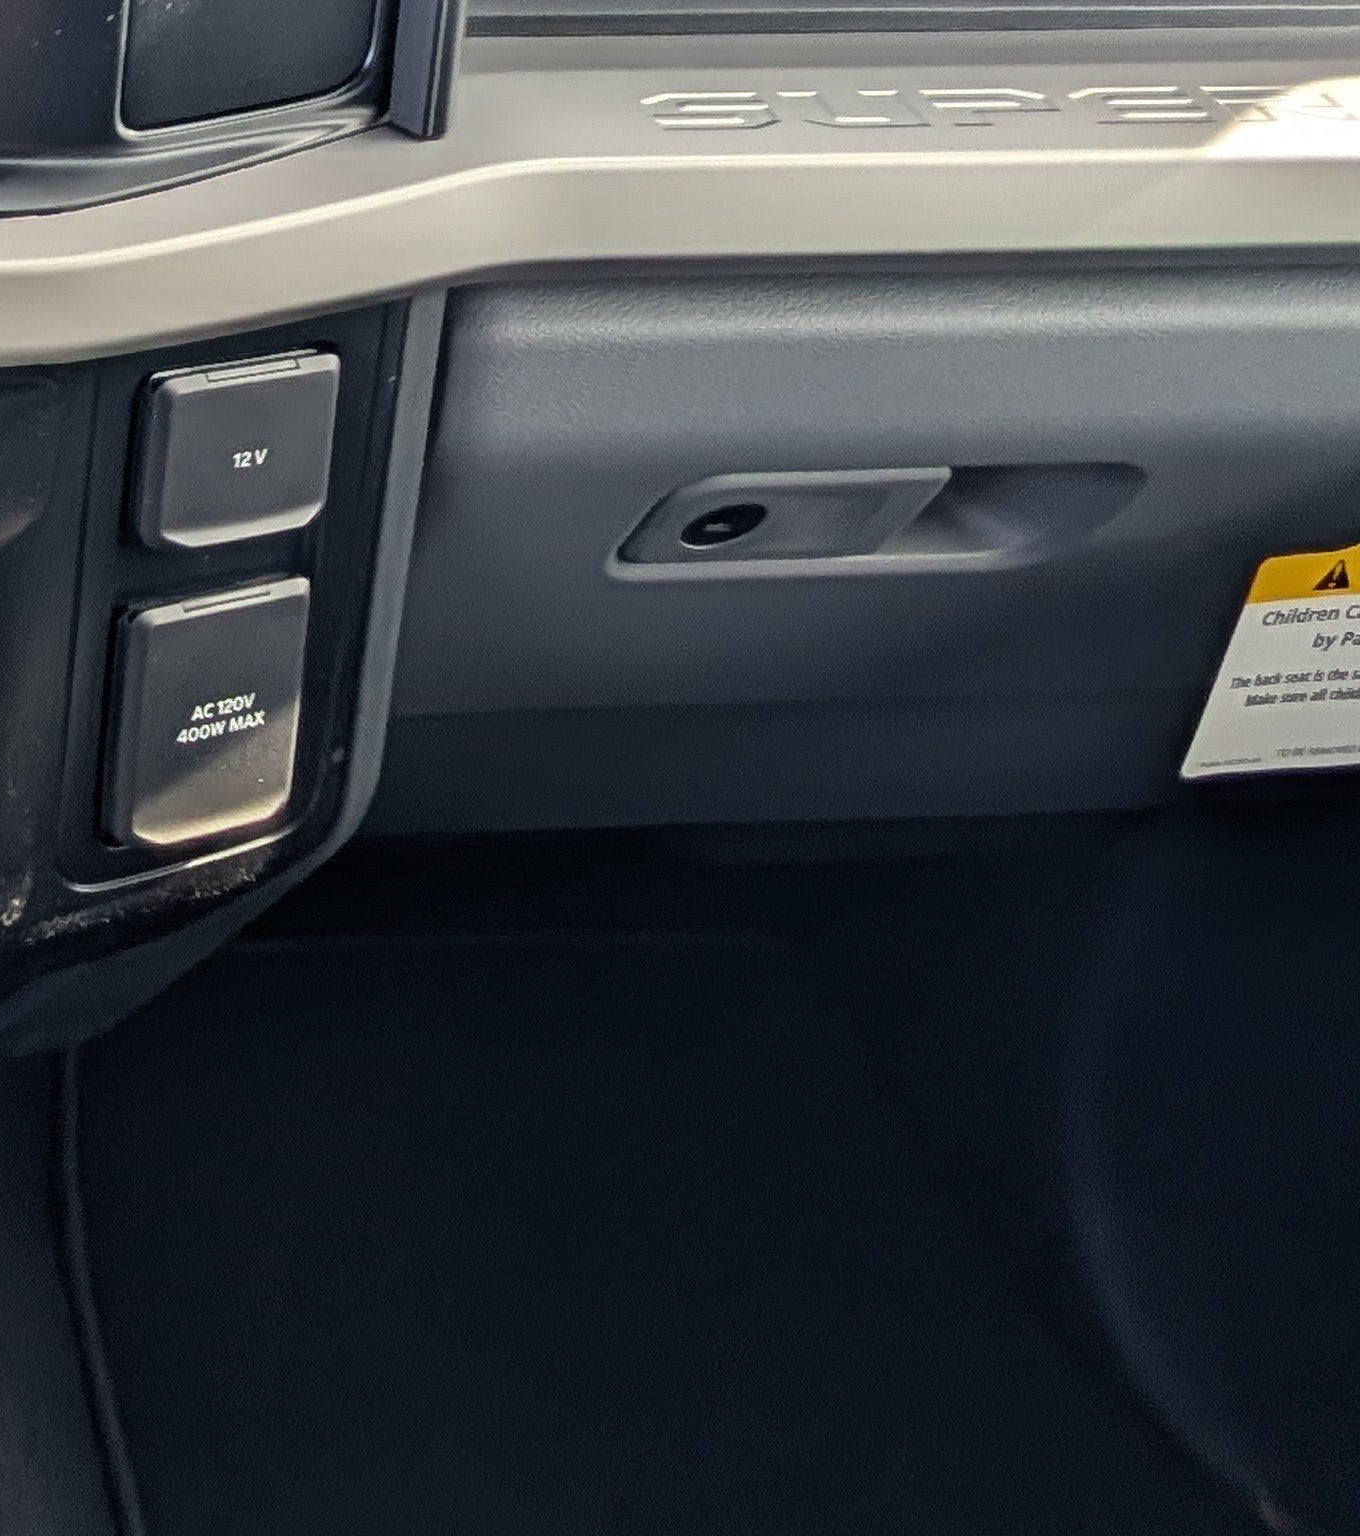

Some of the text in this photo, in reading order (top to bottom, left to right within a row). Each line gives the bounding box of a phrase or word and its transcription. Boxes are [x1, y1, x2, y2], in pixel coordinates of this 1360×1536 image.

[232, 447, 269, 469] 12 V
[1262, 607, 1340, 626] Children
[1312, 632, 1339, 652] by
[190, 692, 256, 722] AC 120V
[176, 709, 267, 745] 400W MAX
